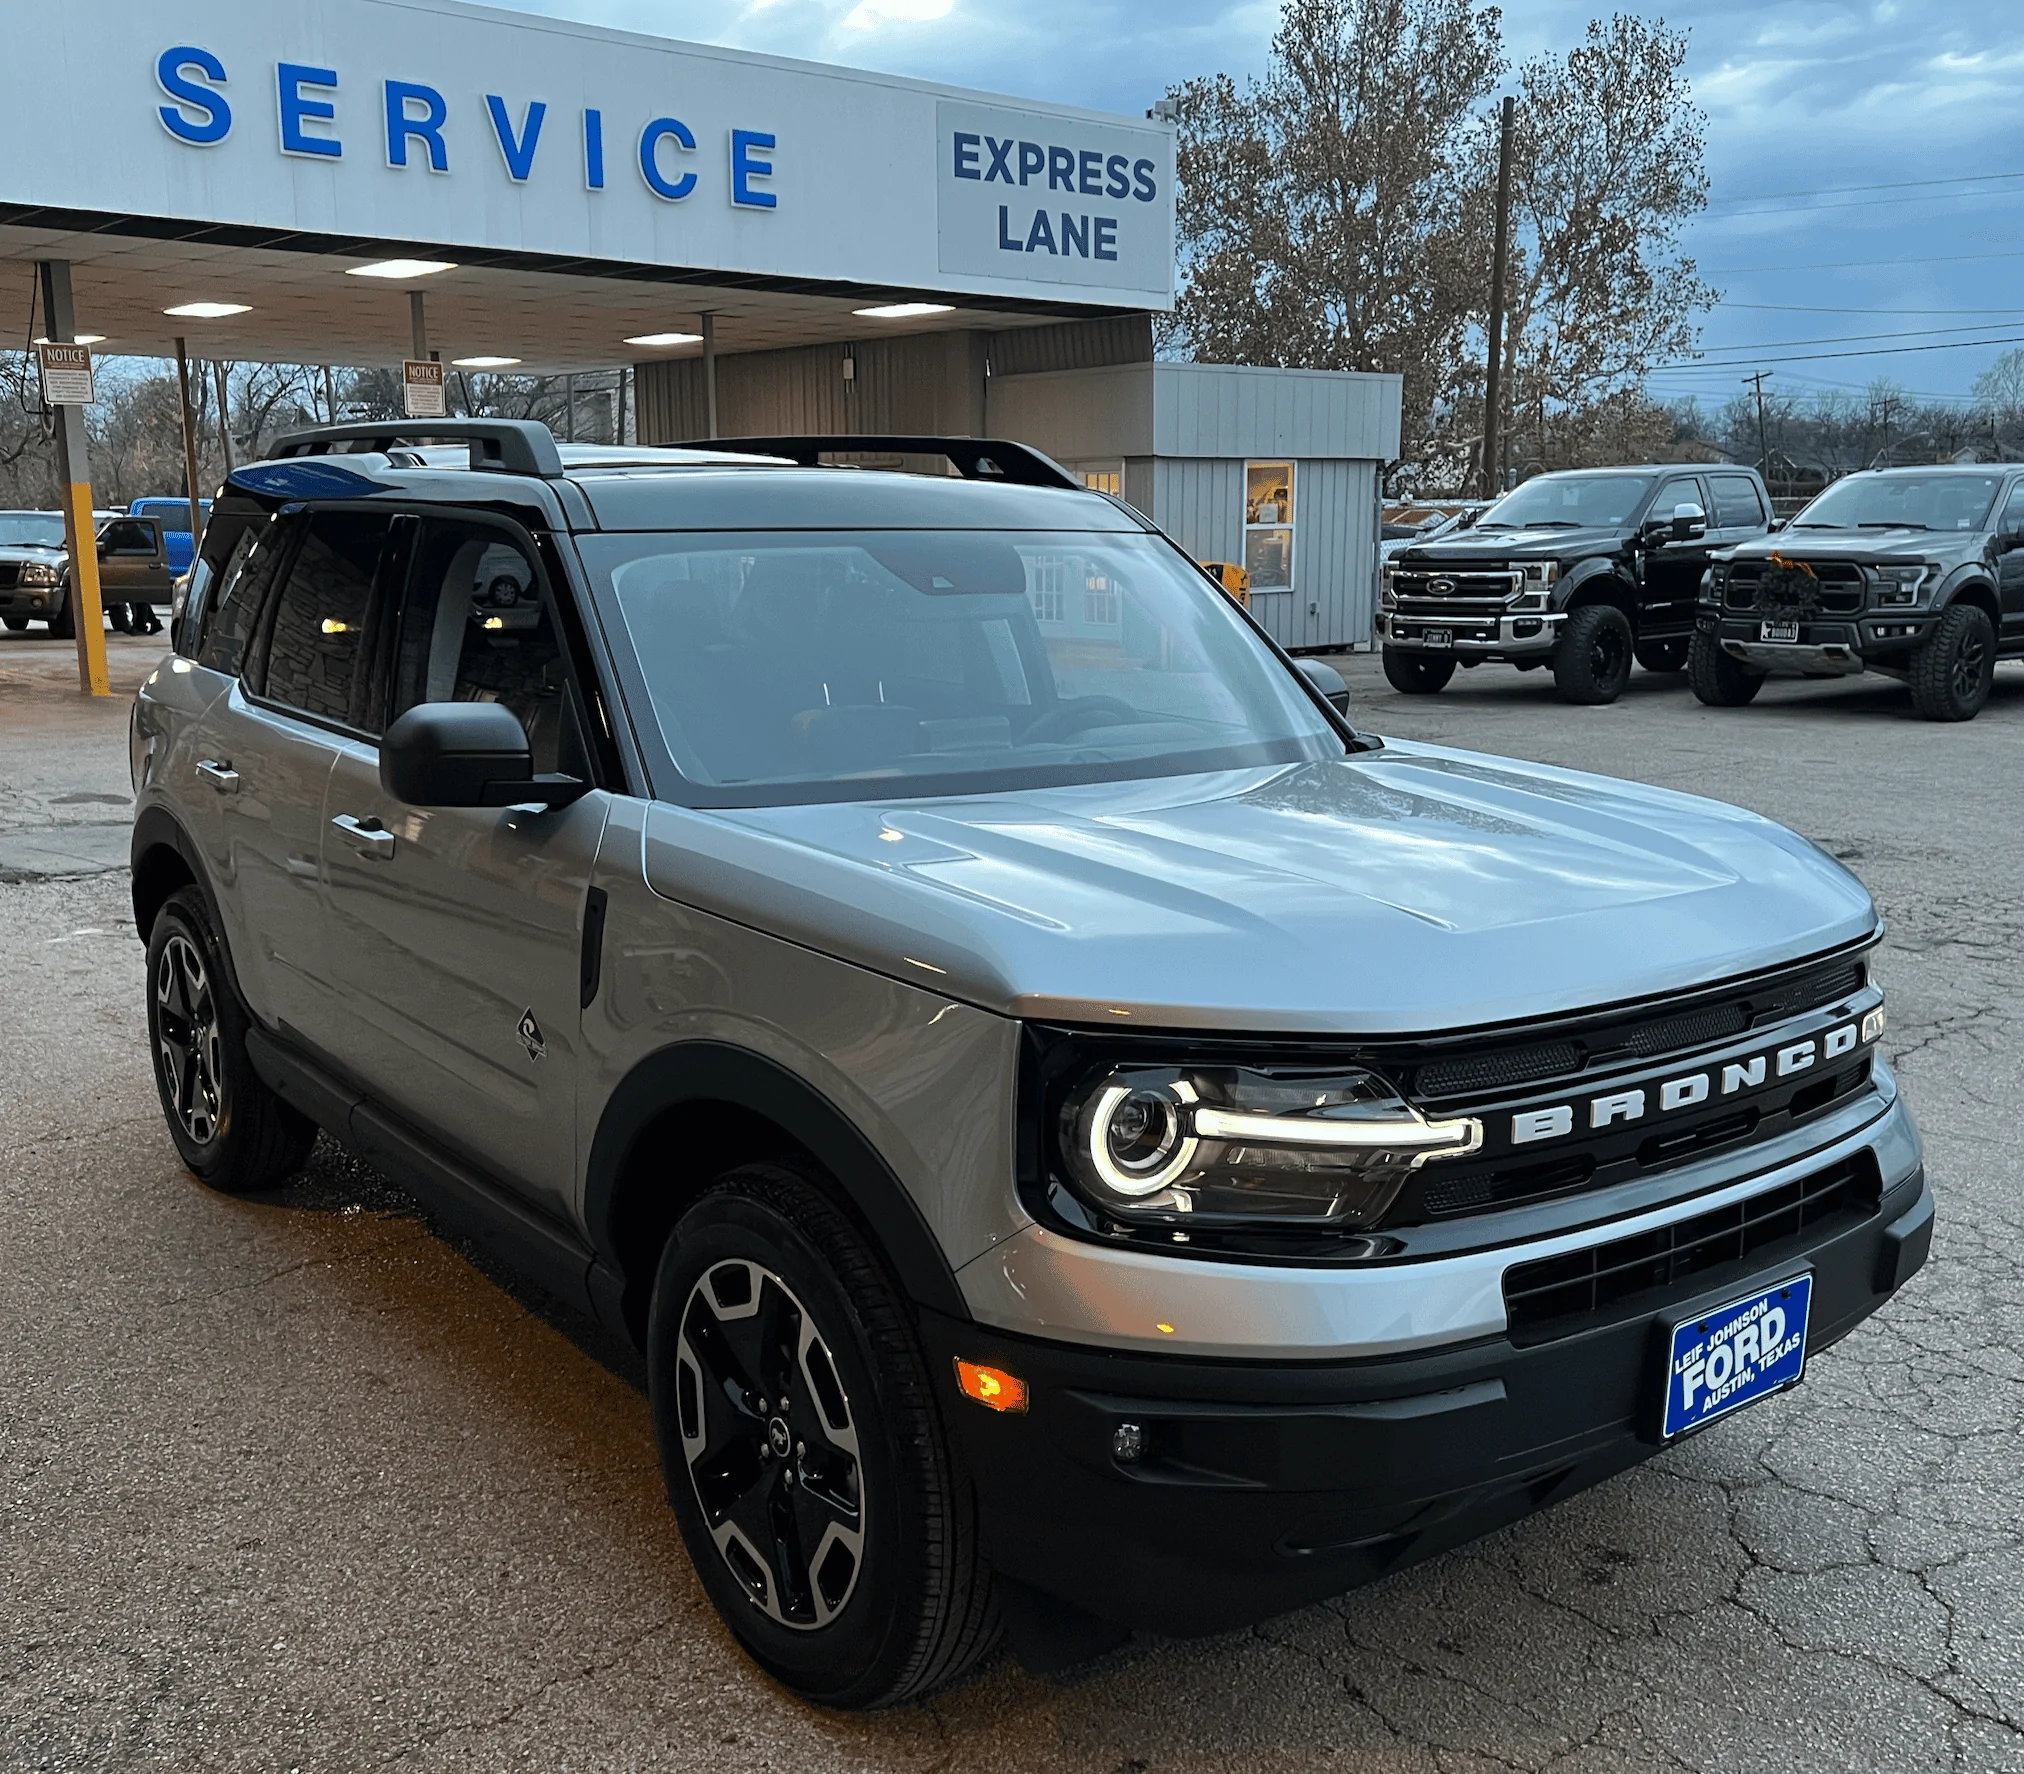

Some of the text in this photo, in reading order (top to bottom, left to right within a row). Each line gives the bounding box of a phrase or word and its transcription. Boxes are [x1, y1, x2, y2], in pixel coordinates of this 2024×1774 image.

[158, 46, 777, 206] SERVICE
[954, 131, 1157, 203] EXPRESS
[999, 204, 1118, 261] LANE
[46, 348, 85, 362] NOTICE
[408, 365, 438, 378] NOTICE
[1510, 1023, 1858, 1145] BRONCO
[1674, 1297, 1769, 1375] LEIF JOHNSON
[1682, 1306, 1786, 1411] FORD
[1702, 1332, 1801, 1414] AUSTIN, TEXAS
